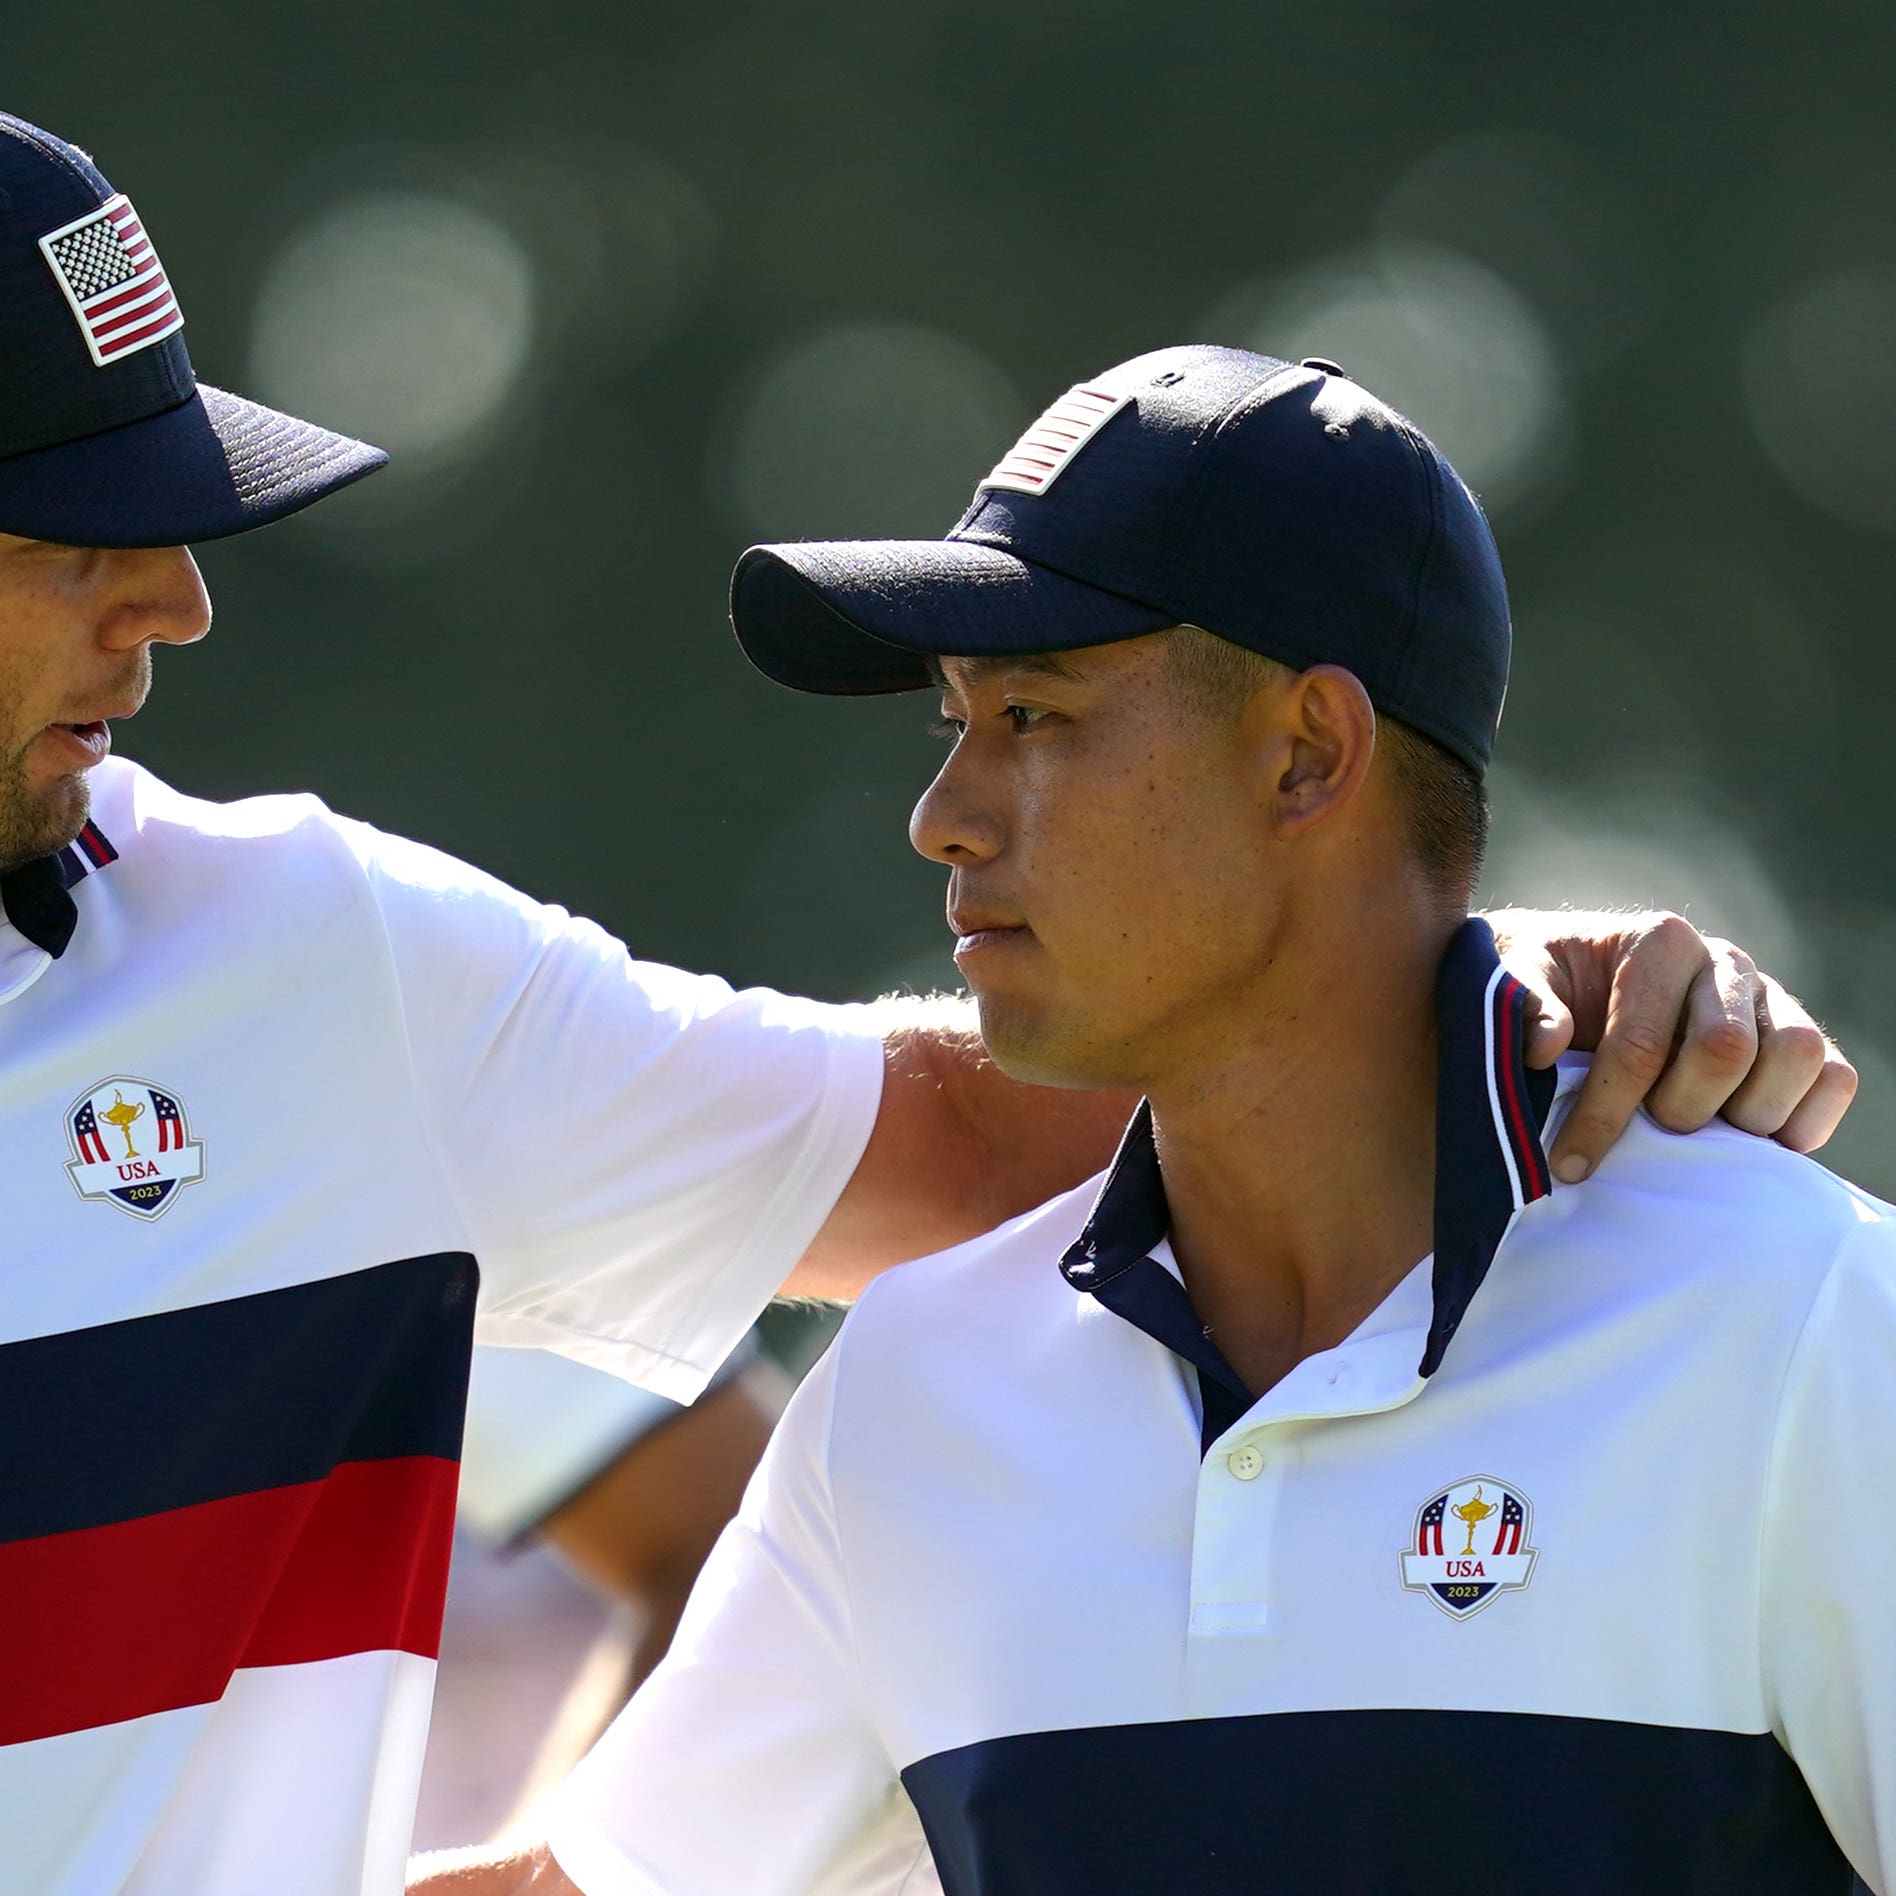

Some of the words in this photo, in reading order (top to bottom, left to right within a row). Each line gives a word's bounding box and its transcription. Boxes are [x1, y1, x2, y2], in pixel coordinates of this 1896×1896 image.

[116, 1159, 161, 1182] USA
[128, 1184, 162, 1201] 2023
[1445, 1560, 1486, 1578] USA
[1447, 1586, 1480, 1598] 2023
